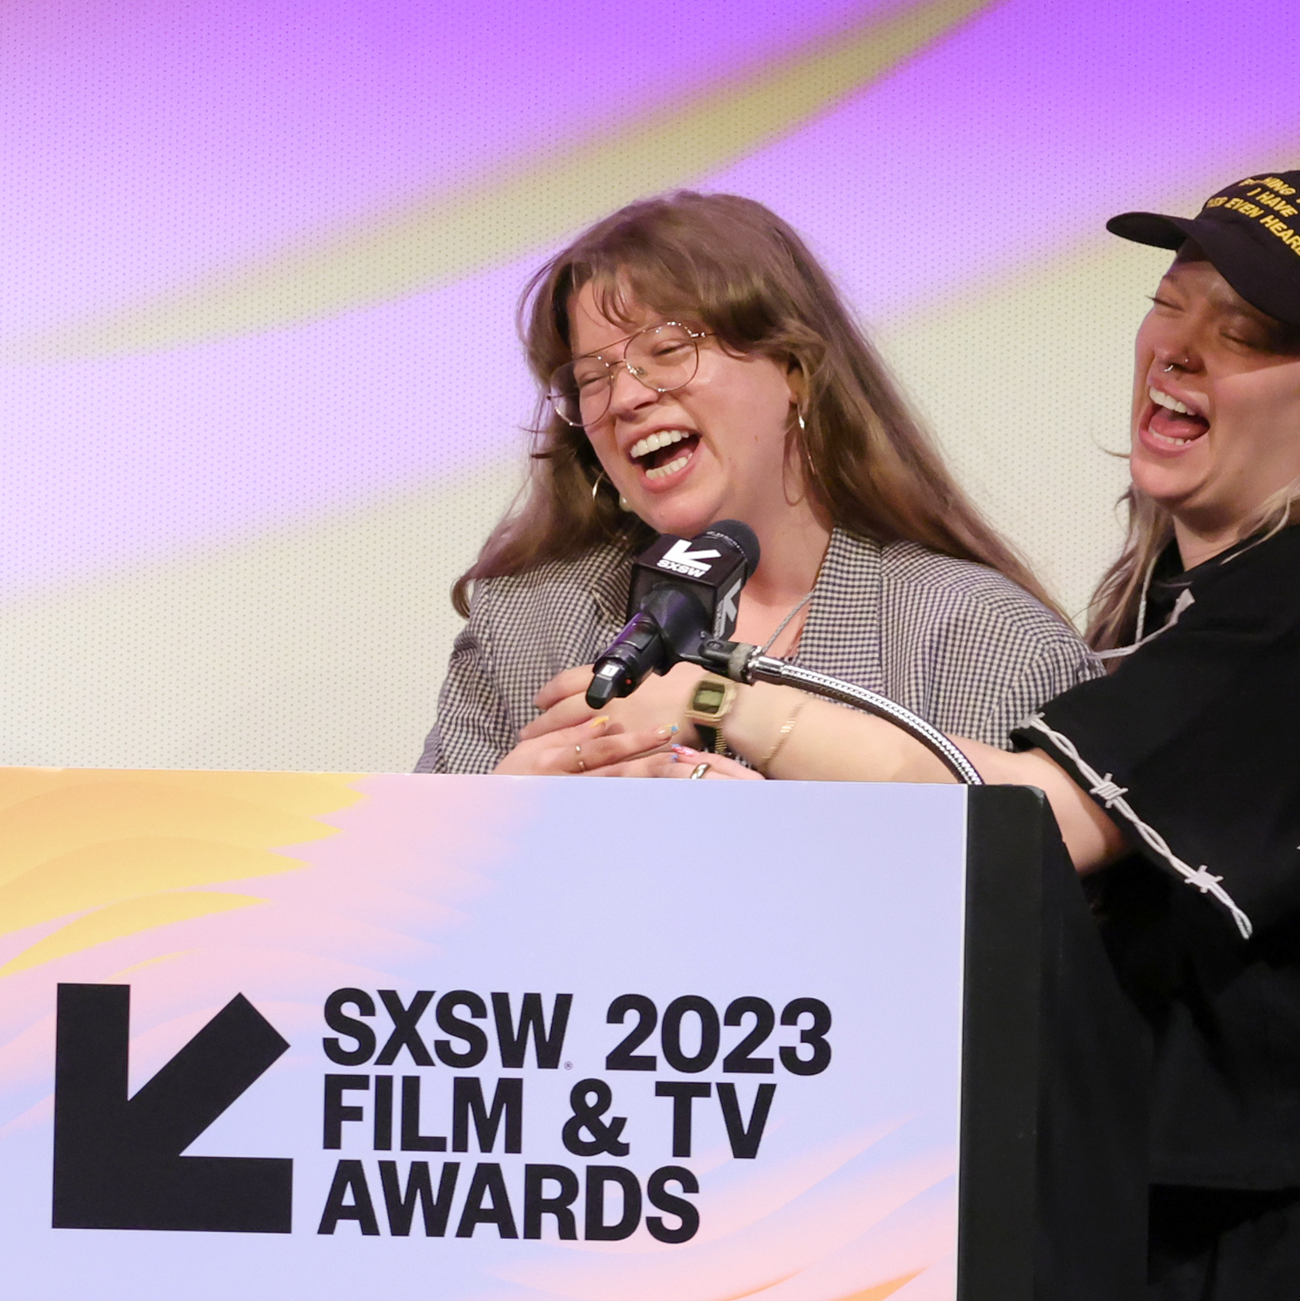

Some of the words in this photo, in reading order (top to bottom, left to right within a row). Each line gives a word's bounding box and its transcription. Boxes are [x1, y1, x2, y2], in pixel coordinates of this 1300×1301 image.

[1224, 198, 1265, 218] EVEN
[1255, 191, 1299, 217] HAVE
[656, 559, 706, 578] SXSW
[323, 988, 572, 1070] SXSW
[606, 994, 832, 1077] 2023
[323, 1074, 524, 1154] FILM
[562, 1079, 630, 1157] &
[655, 1081, 777, 1160] TV
[318, 1160, 700, 1244] AWARDS
